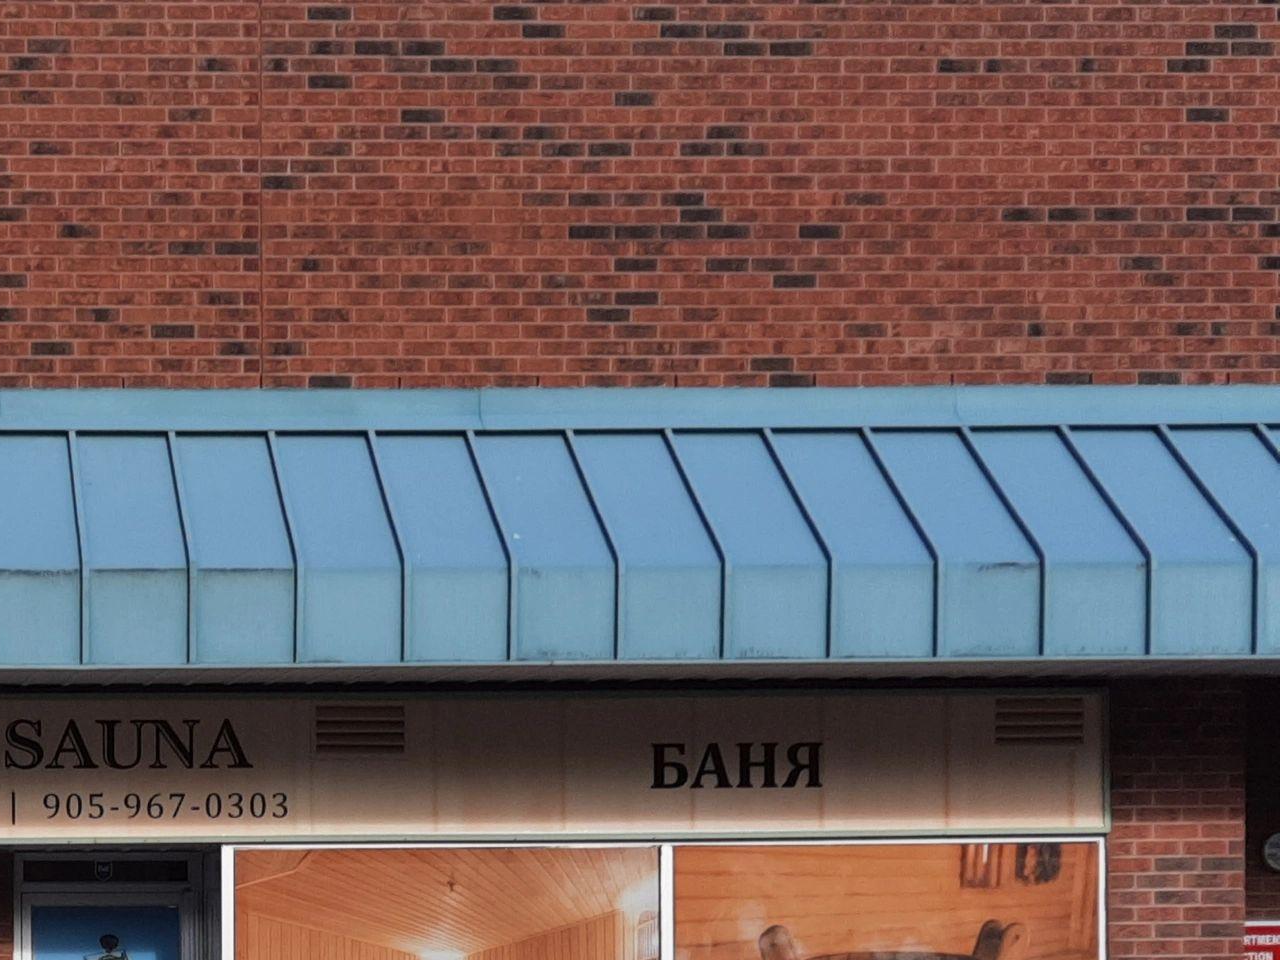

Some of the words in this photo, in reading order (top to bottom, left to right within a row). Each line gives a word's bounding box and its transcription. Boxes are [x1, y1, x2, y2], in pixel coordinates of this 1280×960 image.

[5, 718, 254, 770] SAUNA
[650, 742, 824, 789] БАНЯ
[42, 791, 289, 820] 905-967-0303
